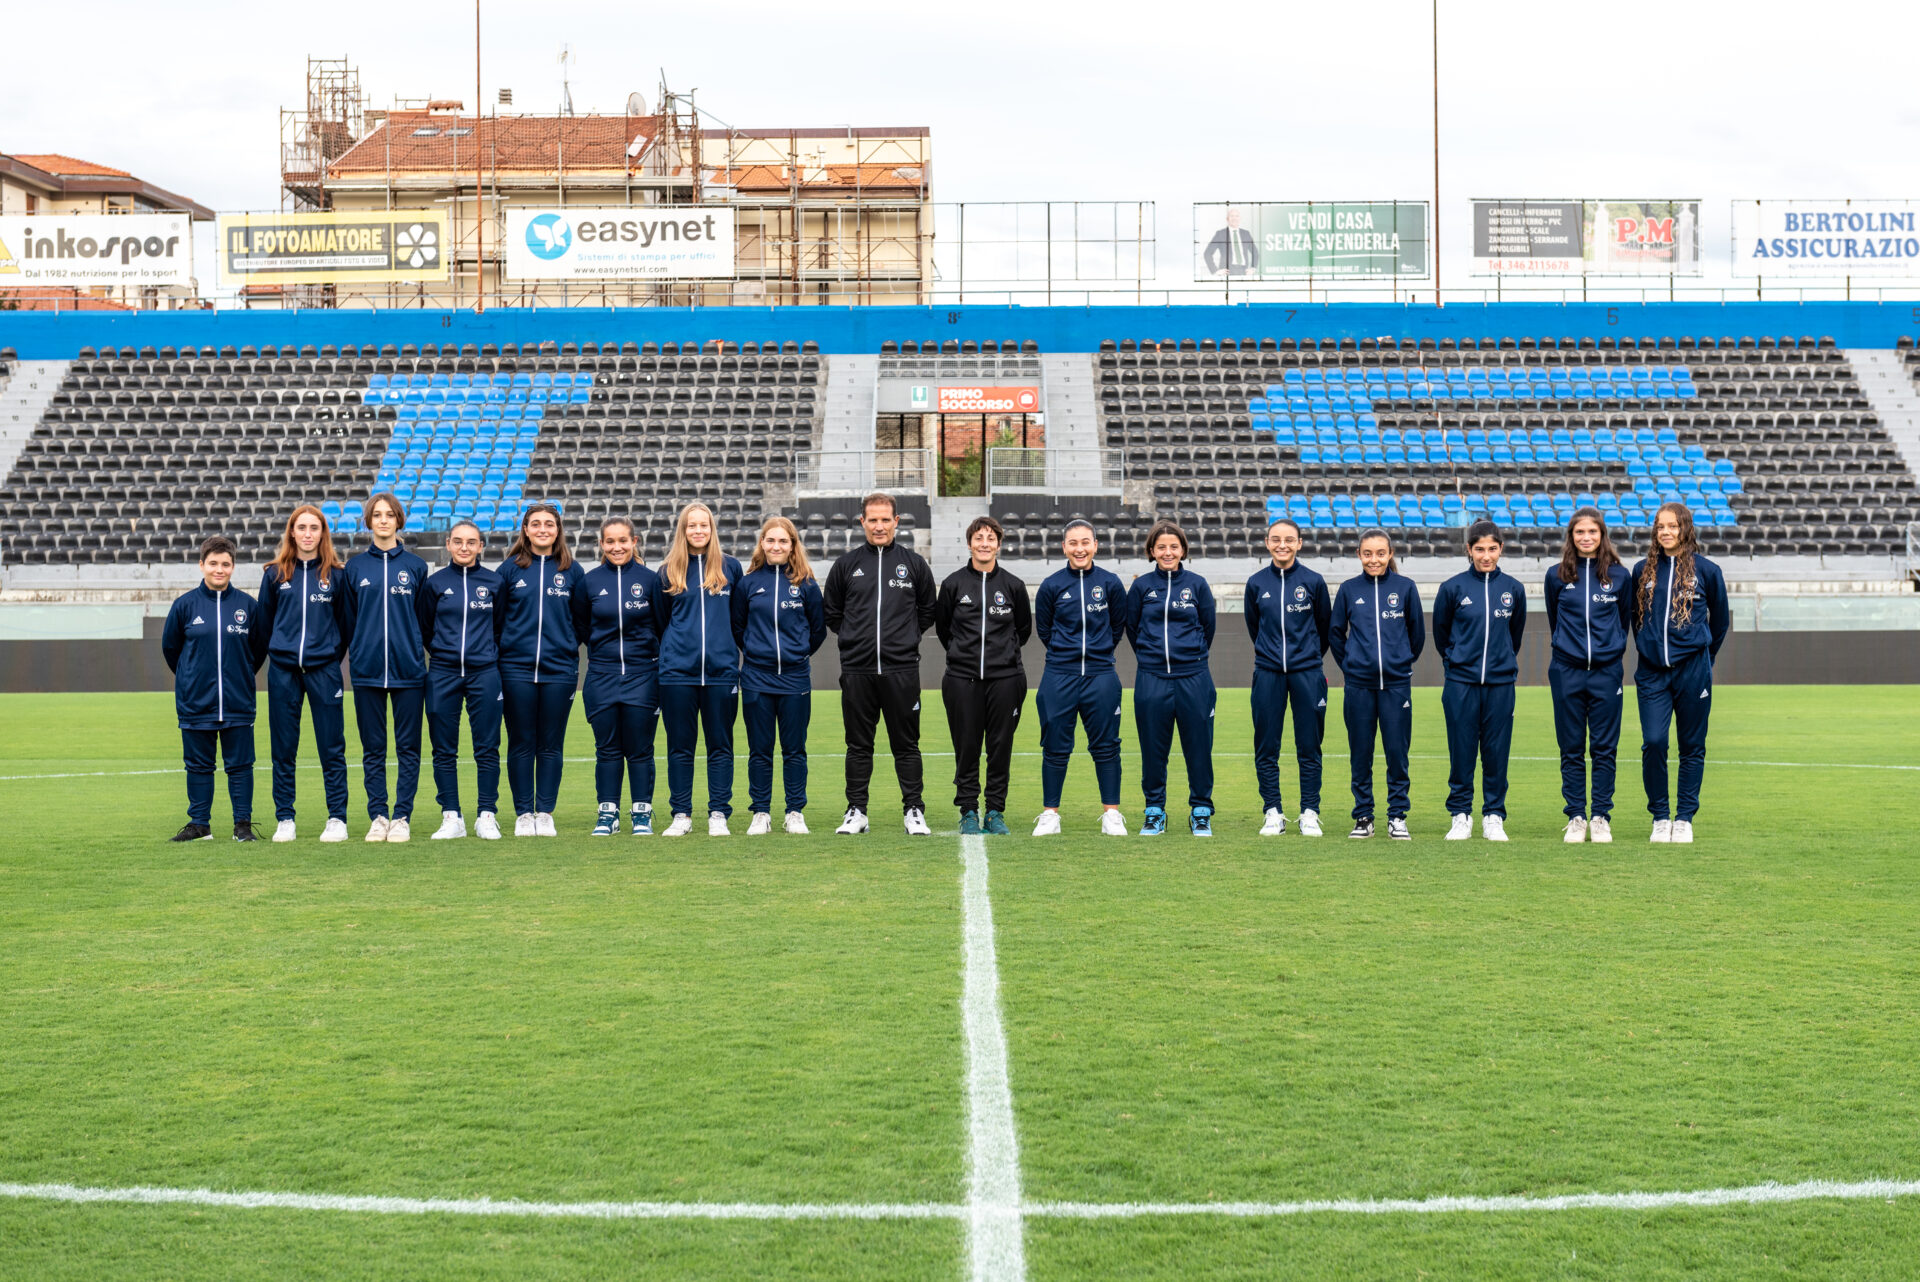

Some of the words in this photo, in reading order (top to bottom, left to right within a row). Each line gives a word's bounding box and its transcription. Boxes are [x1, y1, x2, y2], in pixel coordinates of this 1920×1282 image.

[1488, 208, 1520, 216] CANCELLI
[1288, 212, 1331, 230] VENDI
[1336, 212, 1374, 230] CASA
[1548, 218, 1562, 226] PVC
[1784, 212, 1915, 232] BERTOLINI
[577, 214, 716, 248] easynet
[1616, 218, 1674, 243] P.M
[232, 231, 249, 254] IL
[254, 228, 383, 253] FOTOAMATORE
[1266, 233, 1312, 251] SENZA
[1316, 232, 1401, 250] SVENDERLA
[1534, 236, 1568, 244] SERRANDE
[24, 227, 180, 265] inkospor
[1488, 245, 1530, 253] AVVOLGIBILI
[1752, 238, 1920, 258] ASSICURAZIO
[630, 254, 667, 262] stampa
[670, 254, 686, 262] per
[690, 252, 716, 260] uffici
[574, 266, 668, 275] www.easynetsrl.com
[1488, 260, 1504, 270] Tel.
[1508, 260, 1526, 270] 346
[1528, 260, 1569, 270] 2115678
[25, 270, 41, 278] Dal
[44, 270, 68, 278] 1982
[70, 270, 118, 278] nutrizione
[122, 270, 138, 279] per
[140, 269, 150, 277] lo
[152, 270, 178, 279] sport
[1284, 310, 1297, 324] 7
[940, 388, 984, 399] PRIMO
[940, 399, 1014, 410] SOCCORSO
